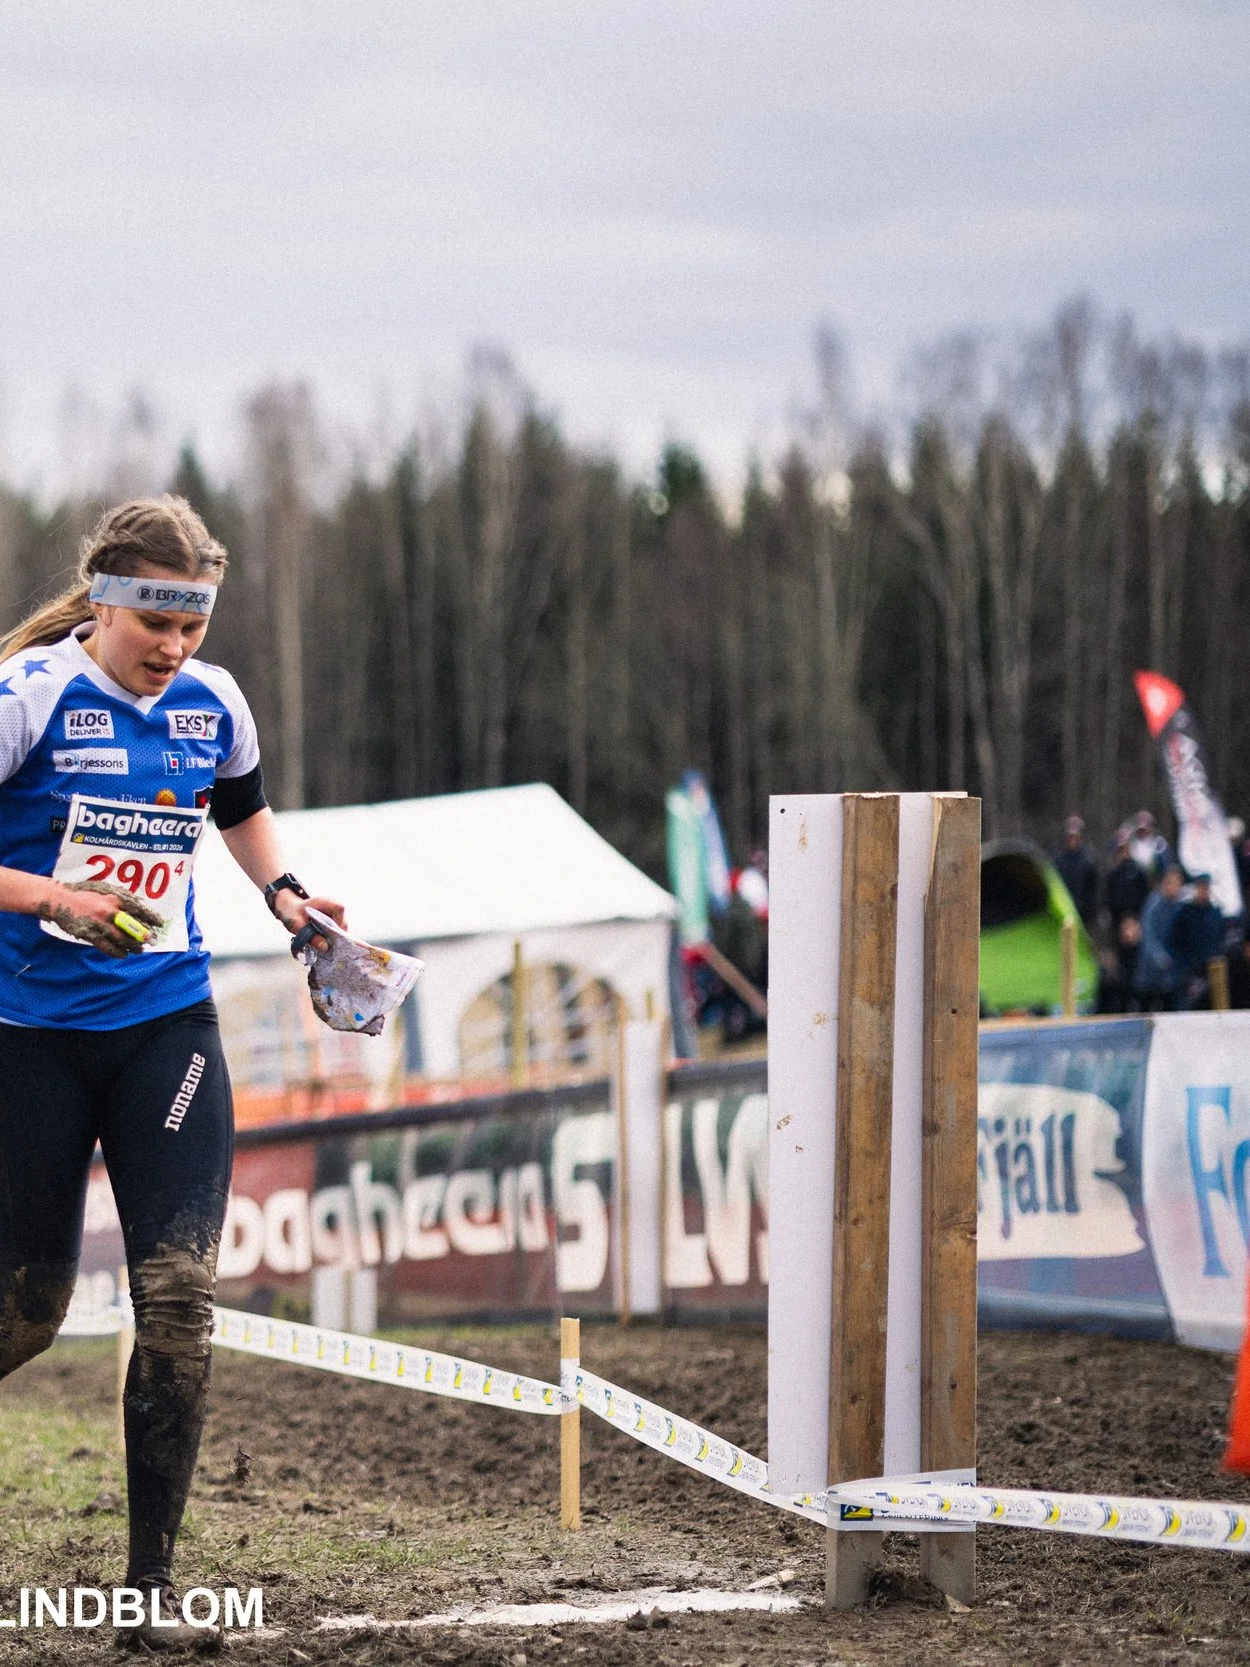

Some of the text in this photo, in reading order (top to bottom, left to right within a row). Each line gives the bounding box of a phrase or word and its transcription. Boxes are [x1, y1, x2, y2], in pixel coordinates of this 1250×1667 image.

[156, 589, 211, 604] BRYZOS
[70, 712, 108, 727] iLOG
[76, 805, 203, 838] bagheera
[169, 844, 184, 852] 2026
[85, 854, 185, 900] 290 4
[164, 1053, 206, 1132] noname
